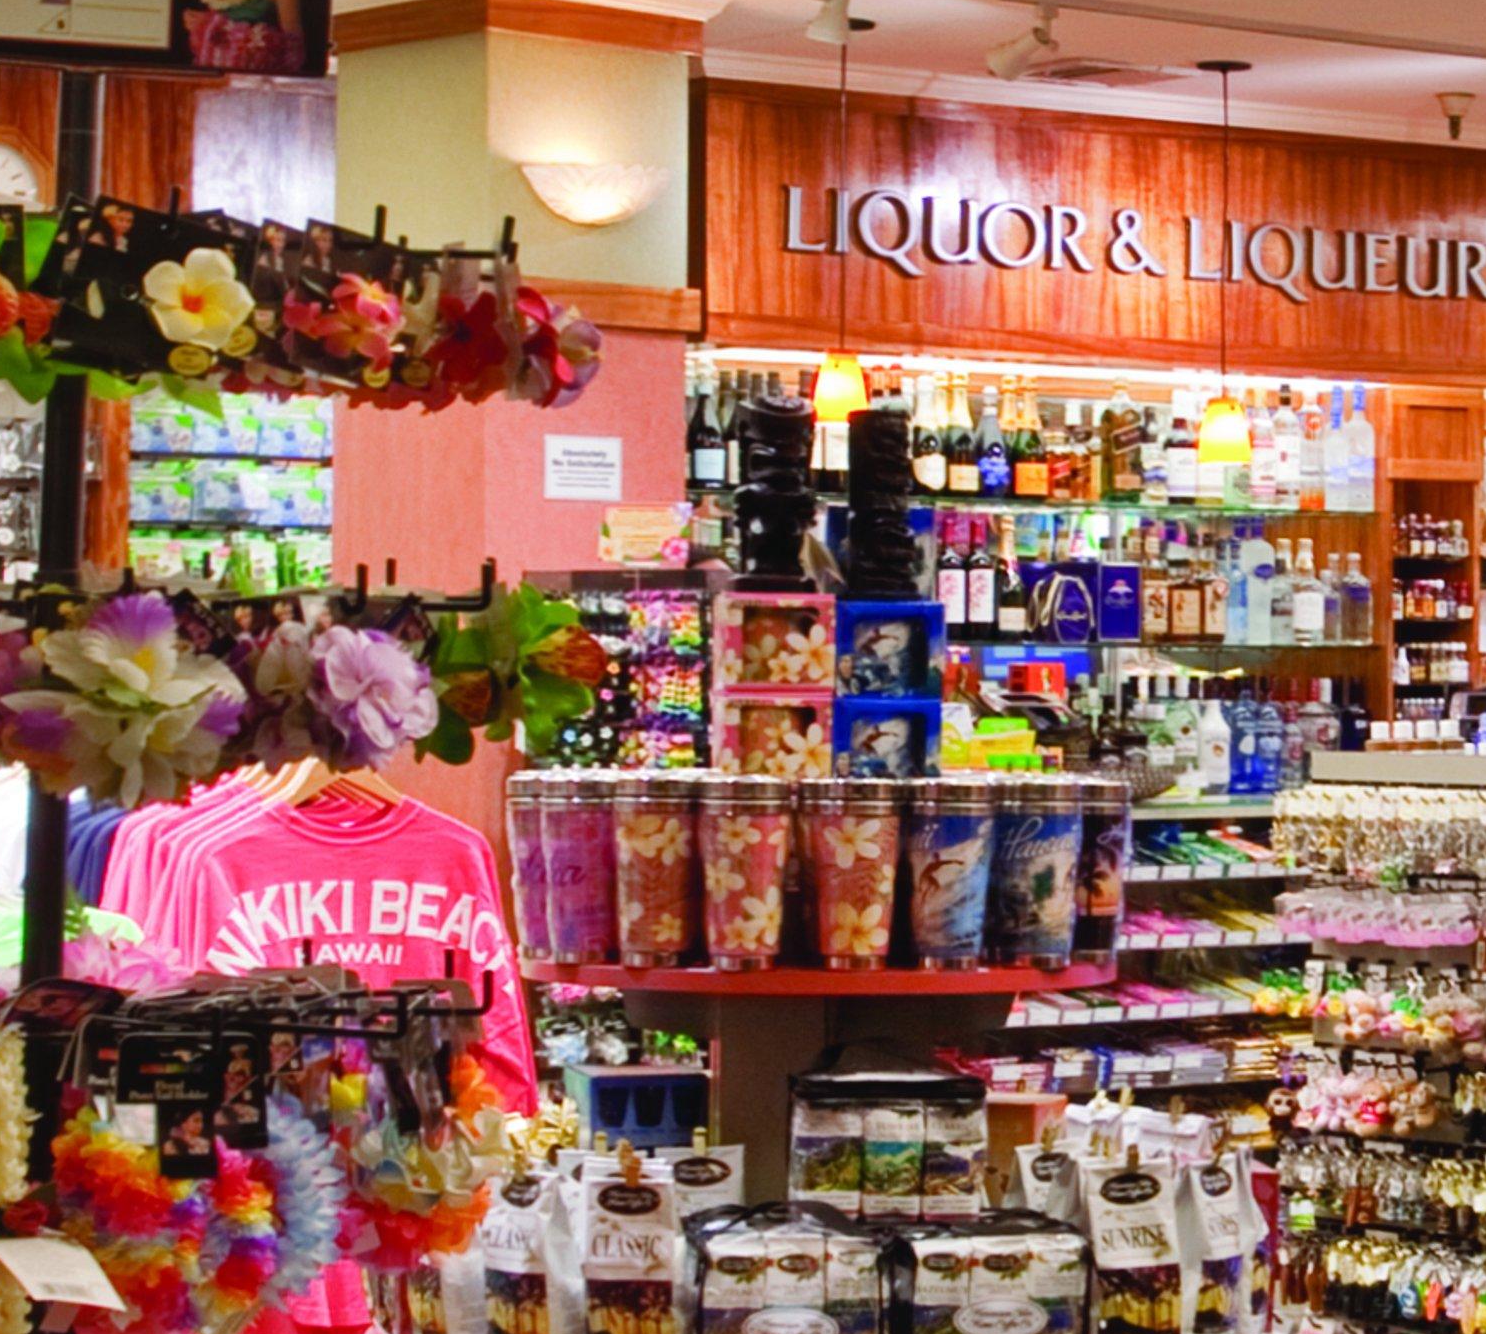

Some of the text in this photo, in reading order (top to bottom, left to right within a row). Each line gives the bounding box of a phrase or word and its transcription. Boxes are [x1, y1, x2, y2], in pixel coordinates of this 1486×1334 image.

[784, 184, 1094, 276] LIQUOR
[1107, 208, 1166, 275] &
[590, 1233, 664, 1260] CLASSIC
